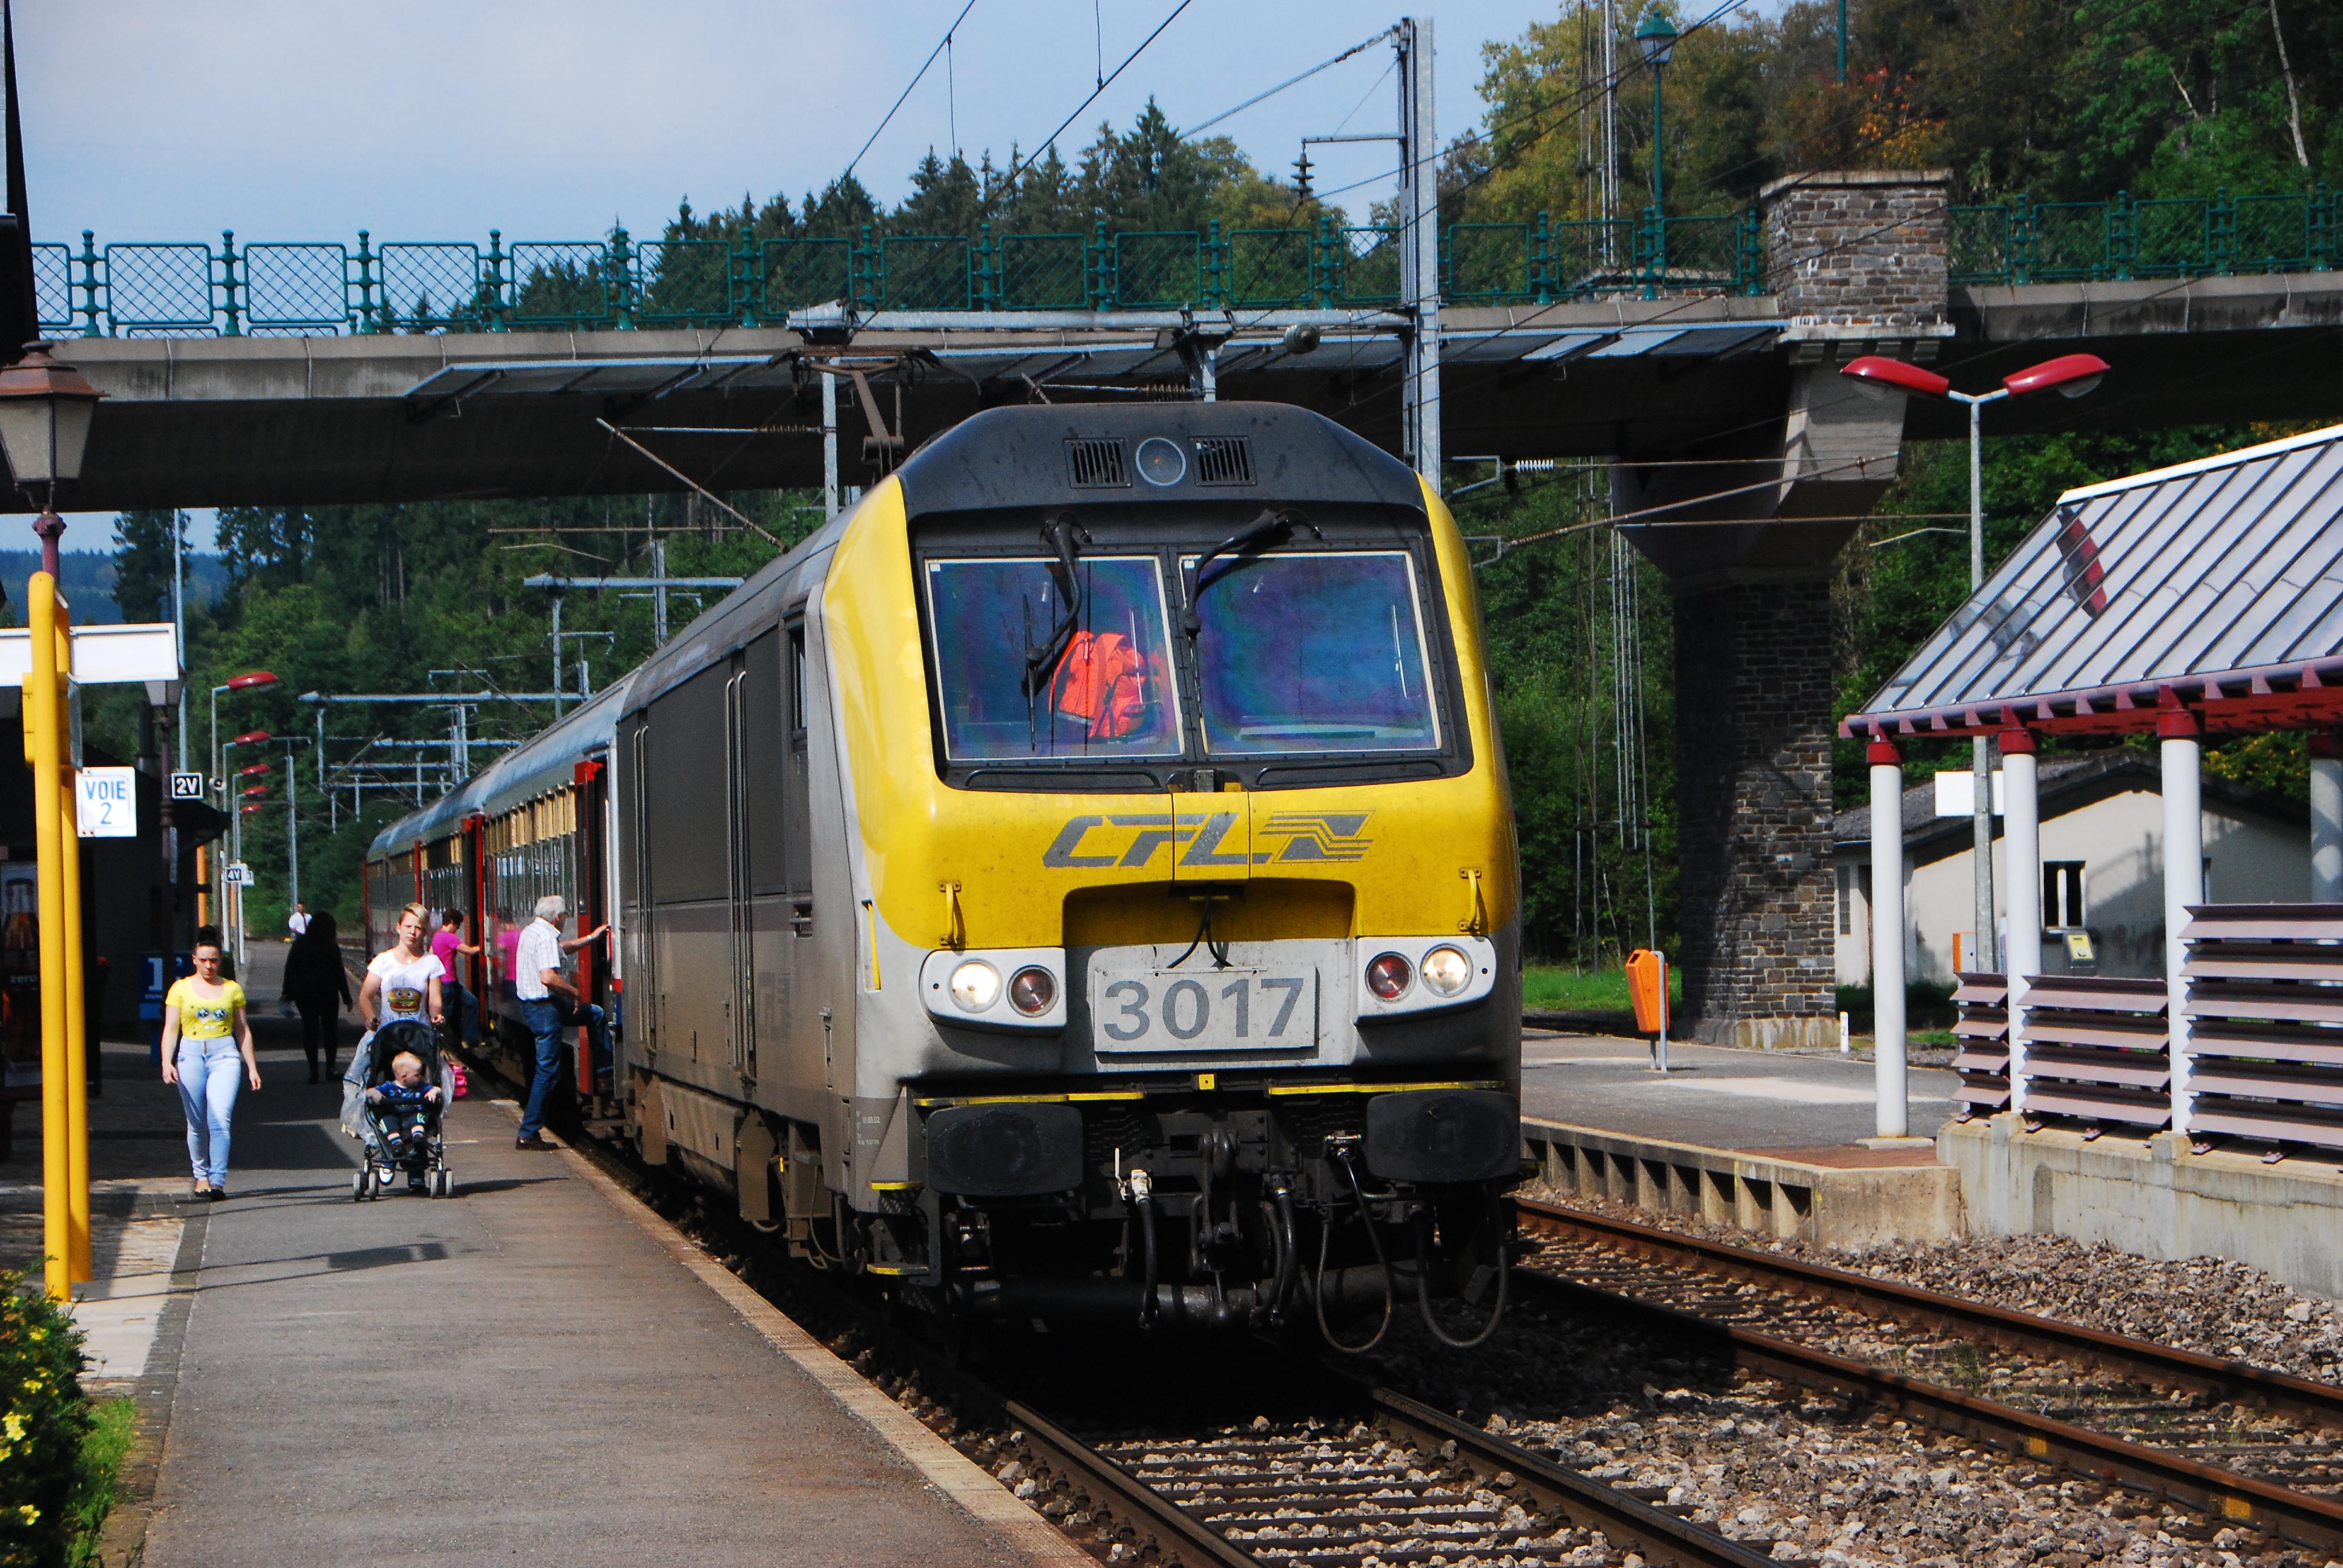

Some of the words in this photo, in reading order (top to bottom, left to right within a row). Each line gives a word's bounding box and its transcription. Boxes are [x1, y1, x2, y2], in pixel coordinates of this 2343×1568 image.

[85, 780, 126, 800] VOIE
[176, 777, 198, 795] 2V
[100, 802, 112, 825] 2
[1042, 812, 1273, 867] CFL
[10, 975, 38, 984] zero
[1104, 977, 1305, 1041] 3017
